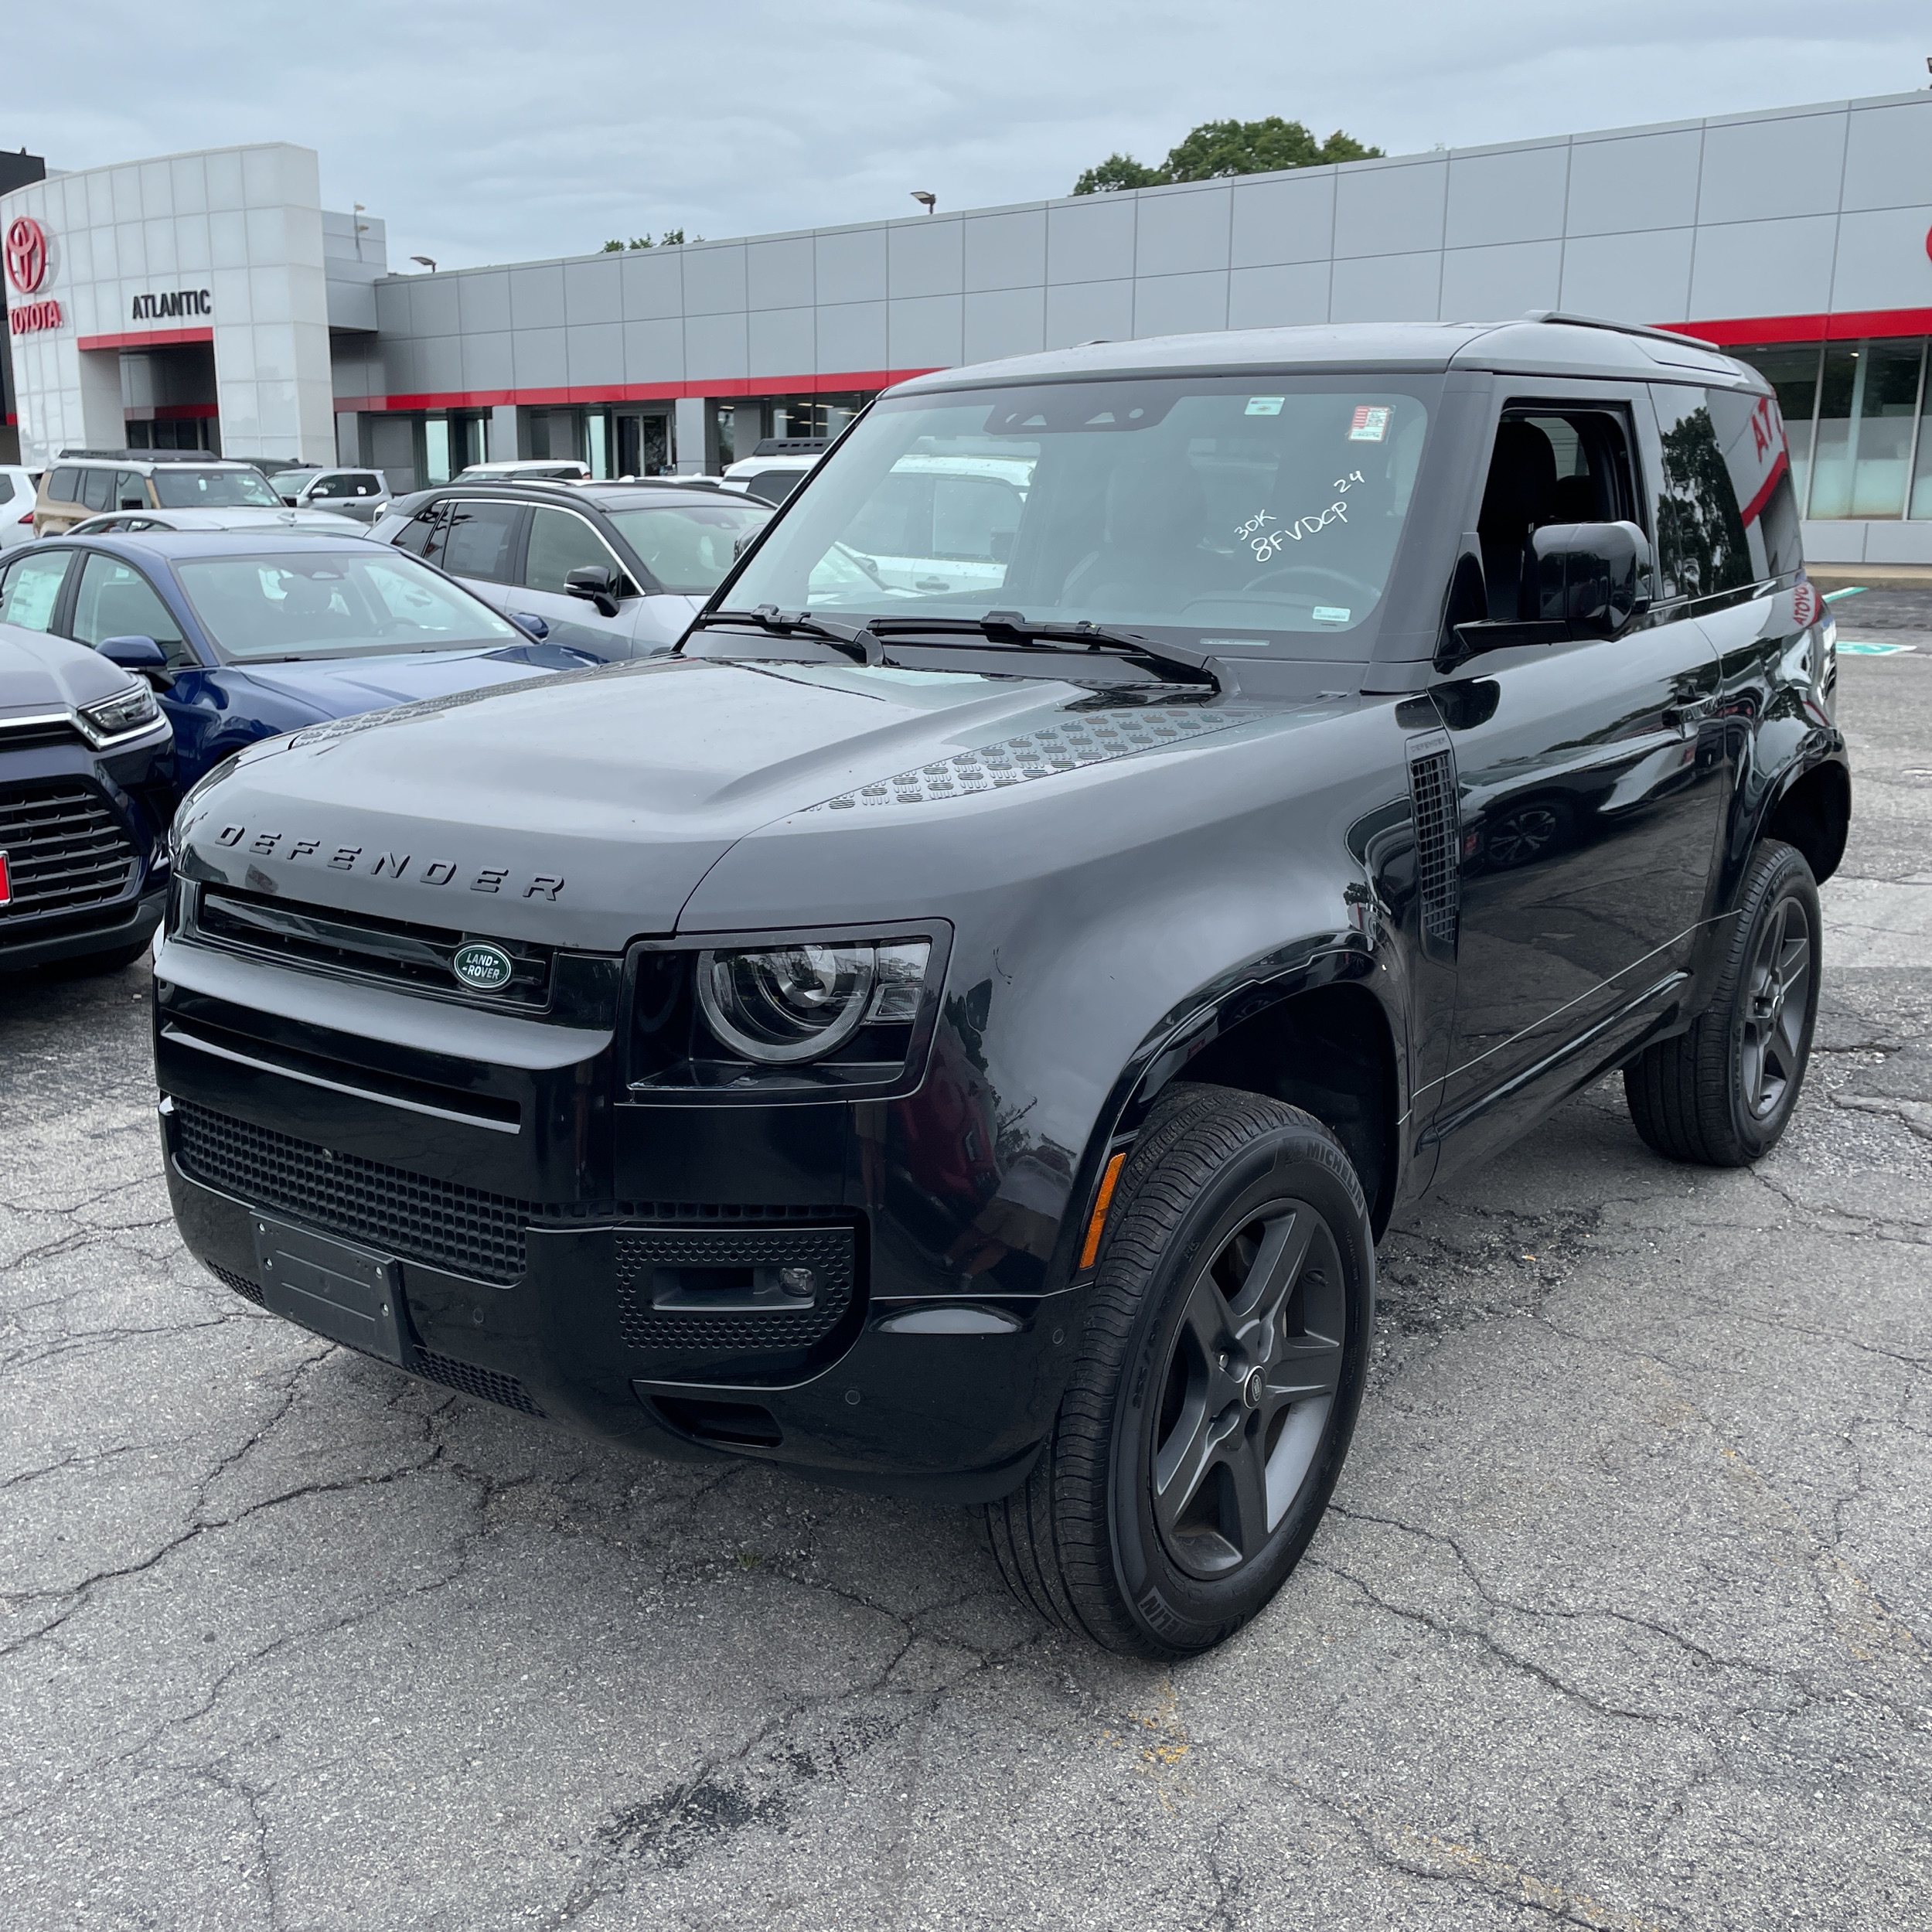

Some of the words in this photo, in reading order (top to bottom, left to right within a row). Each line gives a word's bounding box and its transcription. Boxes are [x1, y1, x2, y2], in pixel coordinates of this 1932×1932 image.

[8, 299, 62, 335] TOYOTA
[132, 289, 212, 319] ATLANTIC
[1334, 471, 1365, 493] 24
[1234, 509, 1277, 540] 30K
[215, 823, 564, 901] DEFENDER
[1306, 1140, 1365, 1210] MICHELIN
